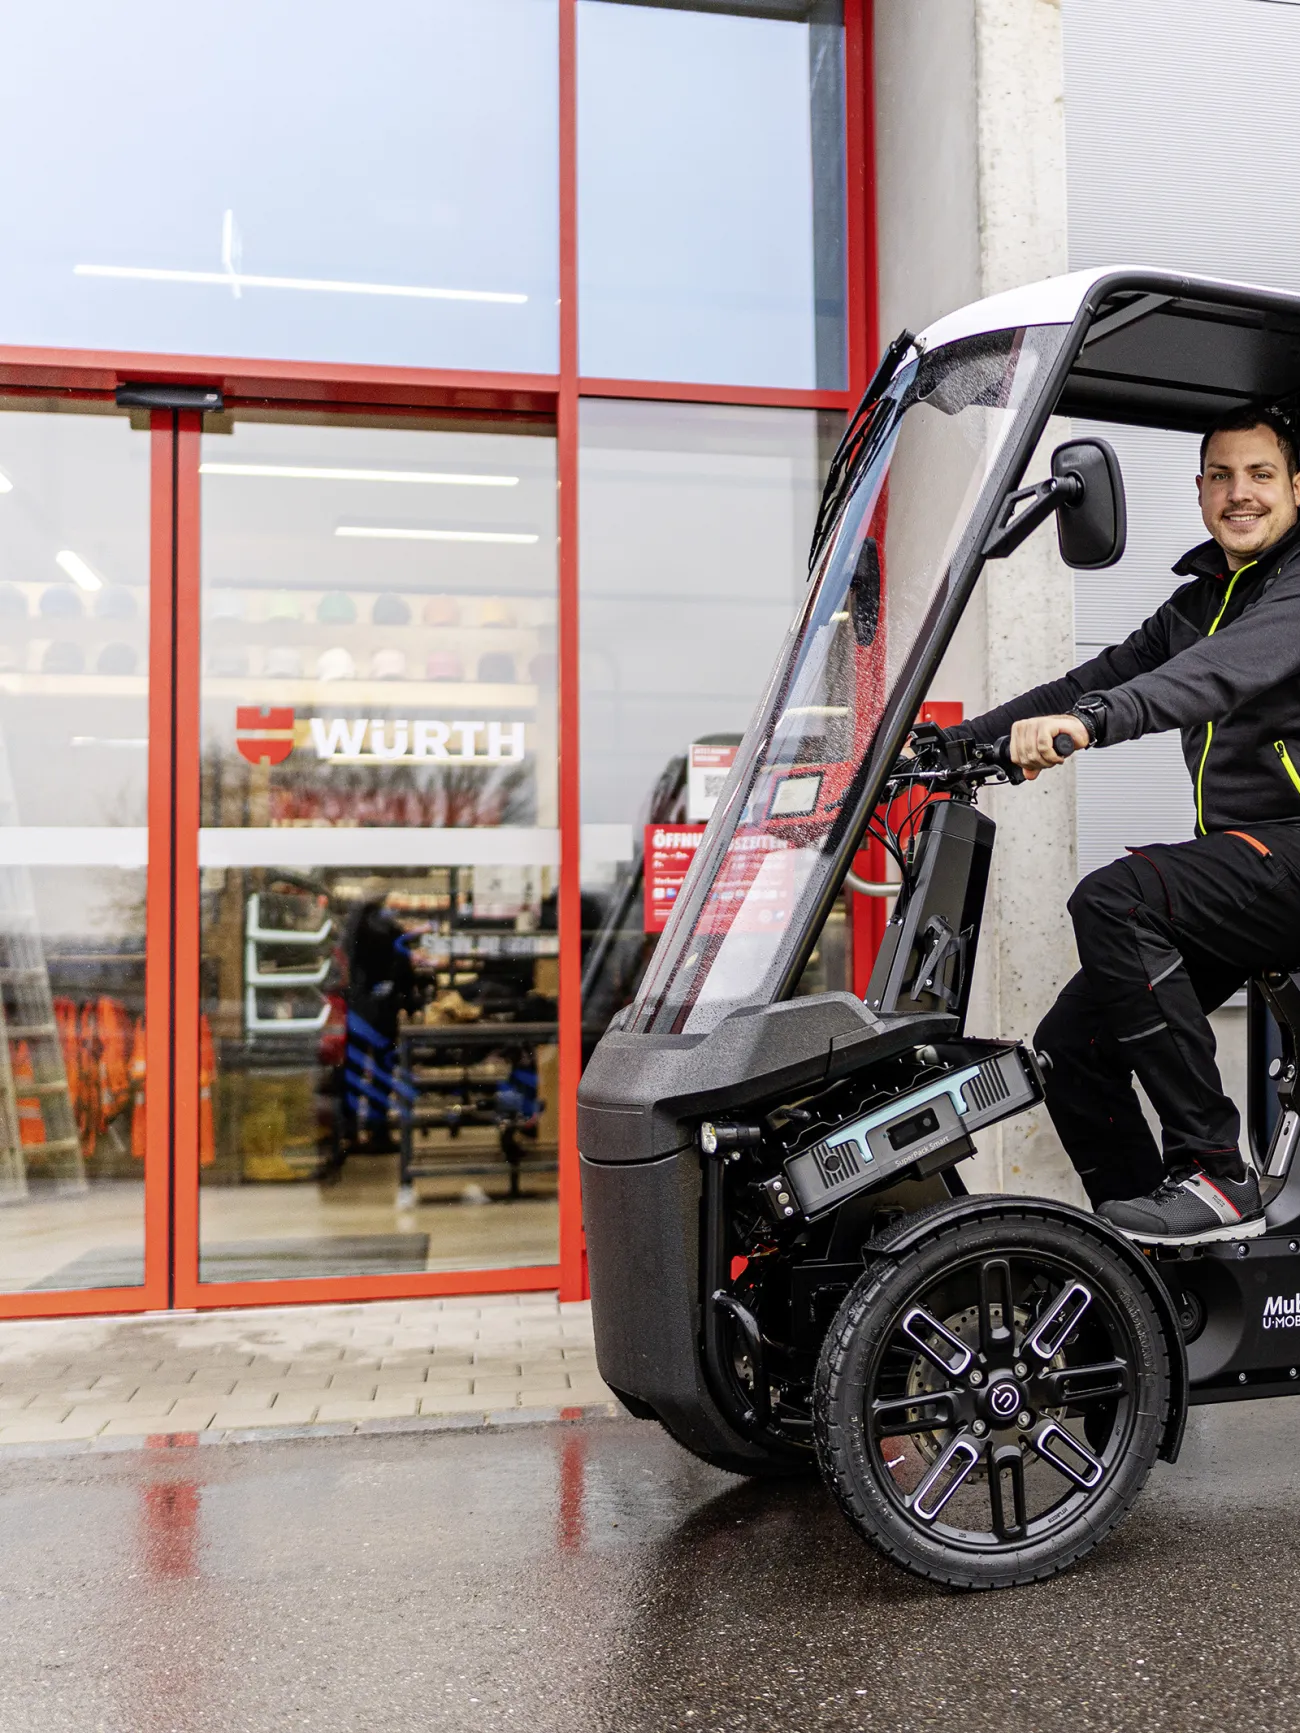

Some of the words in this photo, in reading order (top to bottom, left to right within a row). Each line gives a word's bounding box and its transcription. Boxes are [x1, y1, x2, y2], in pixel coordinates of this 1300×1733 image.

[309, 717, 525, 761] WÜRTH
[894, 1145, 930, 1168] SuperPack
[929, 1135, 950, 1150] Smart
